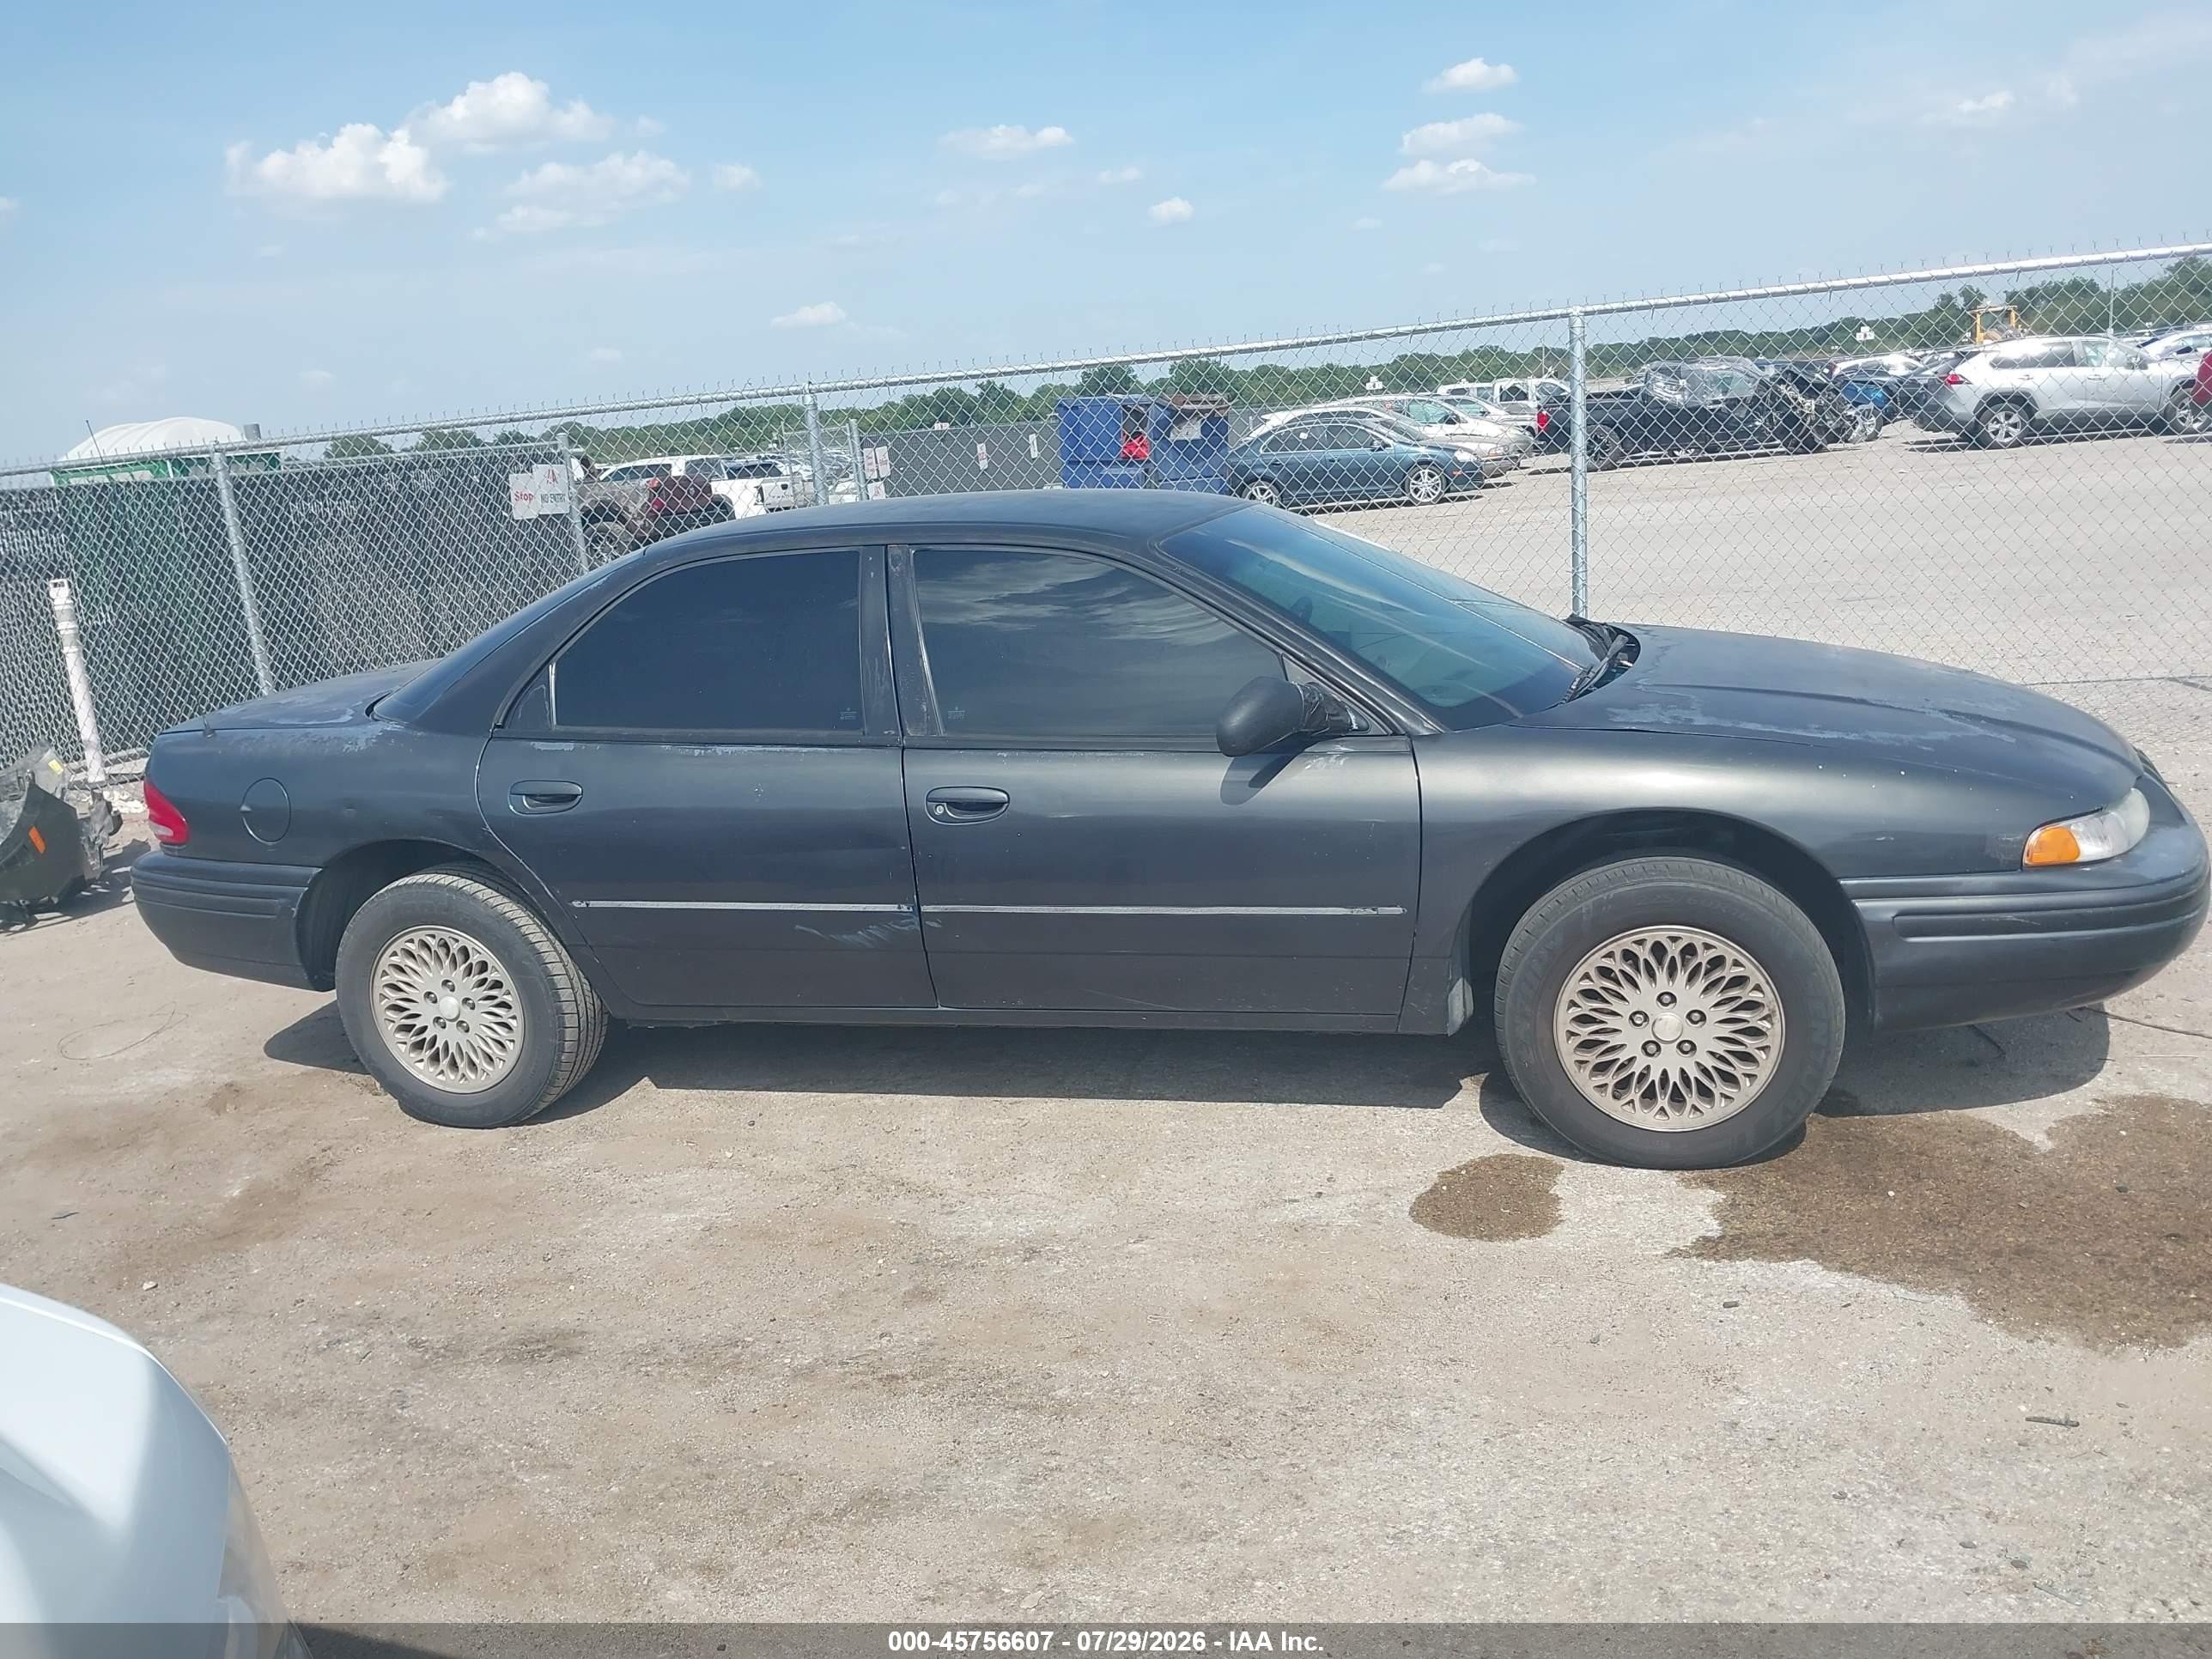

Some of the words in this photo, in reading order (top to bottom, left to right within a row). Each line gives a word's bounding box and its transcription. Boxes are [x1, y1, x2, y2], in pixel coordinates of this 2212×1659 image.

[514, 490, 534, 503] Stop
[540, 494, 550, 503] NO
[550, 493, 566, 503] ENTRY
